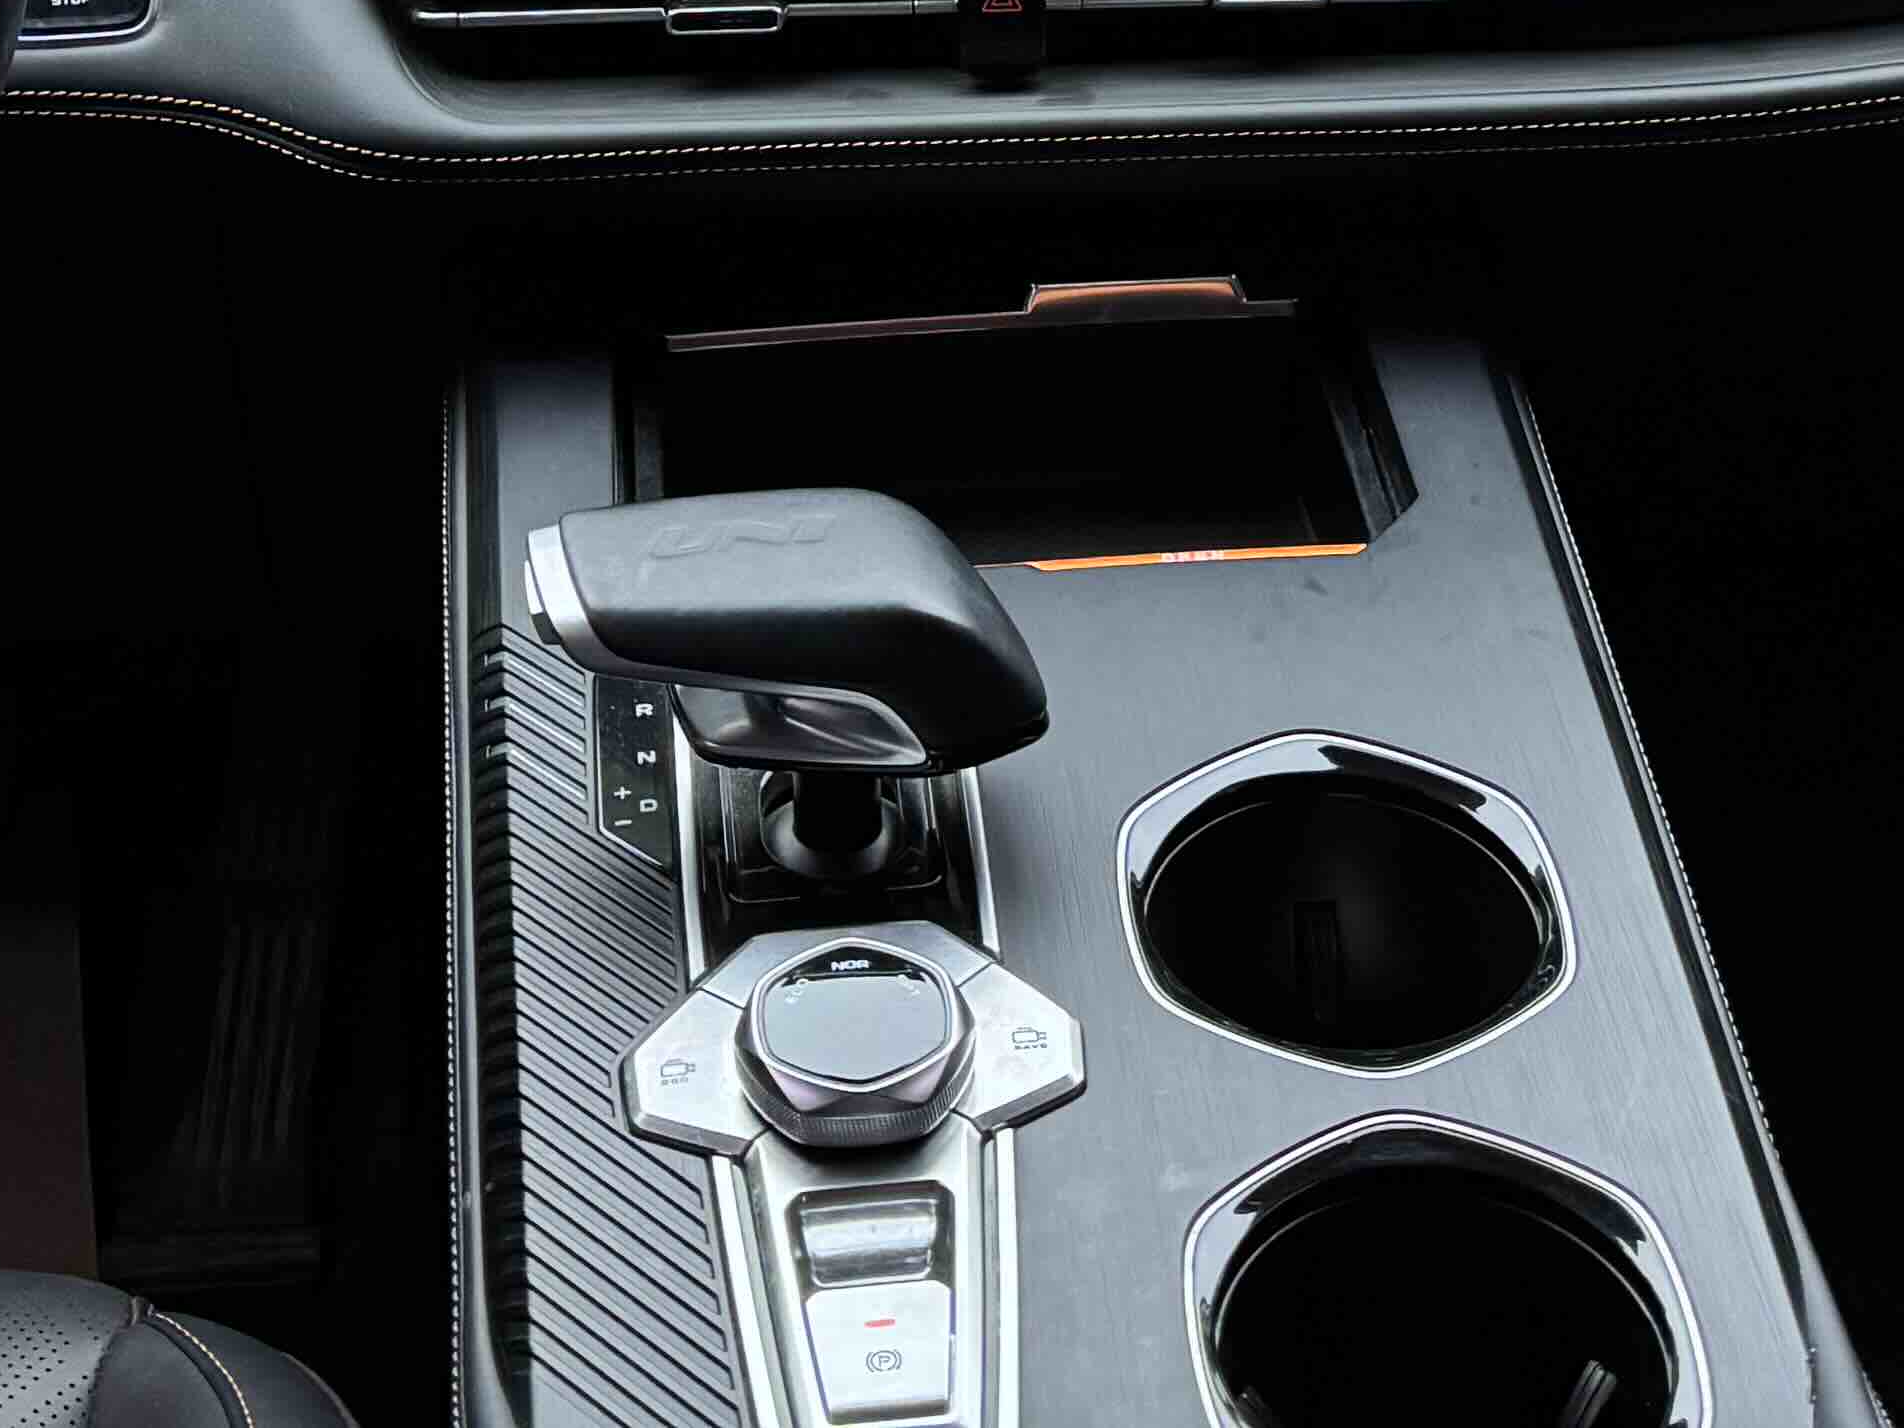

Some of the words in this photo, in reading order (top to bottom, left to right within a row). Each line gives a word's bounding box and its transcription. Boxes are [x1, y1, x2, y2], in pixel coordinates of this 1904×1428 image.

[634, 702, 654, 720] R
[636, 748, 657, 765] N
[639, 797, 658, 814] D
[830, 959, 870, 972] NOR
